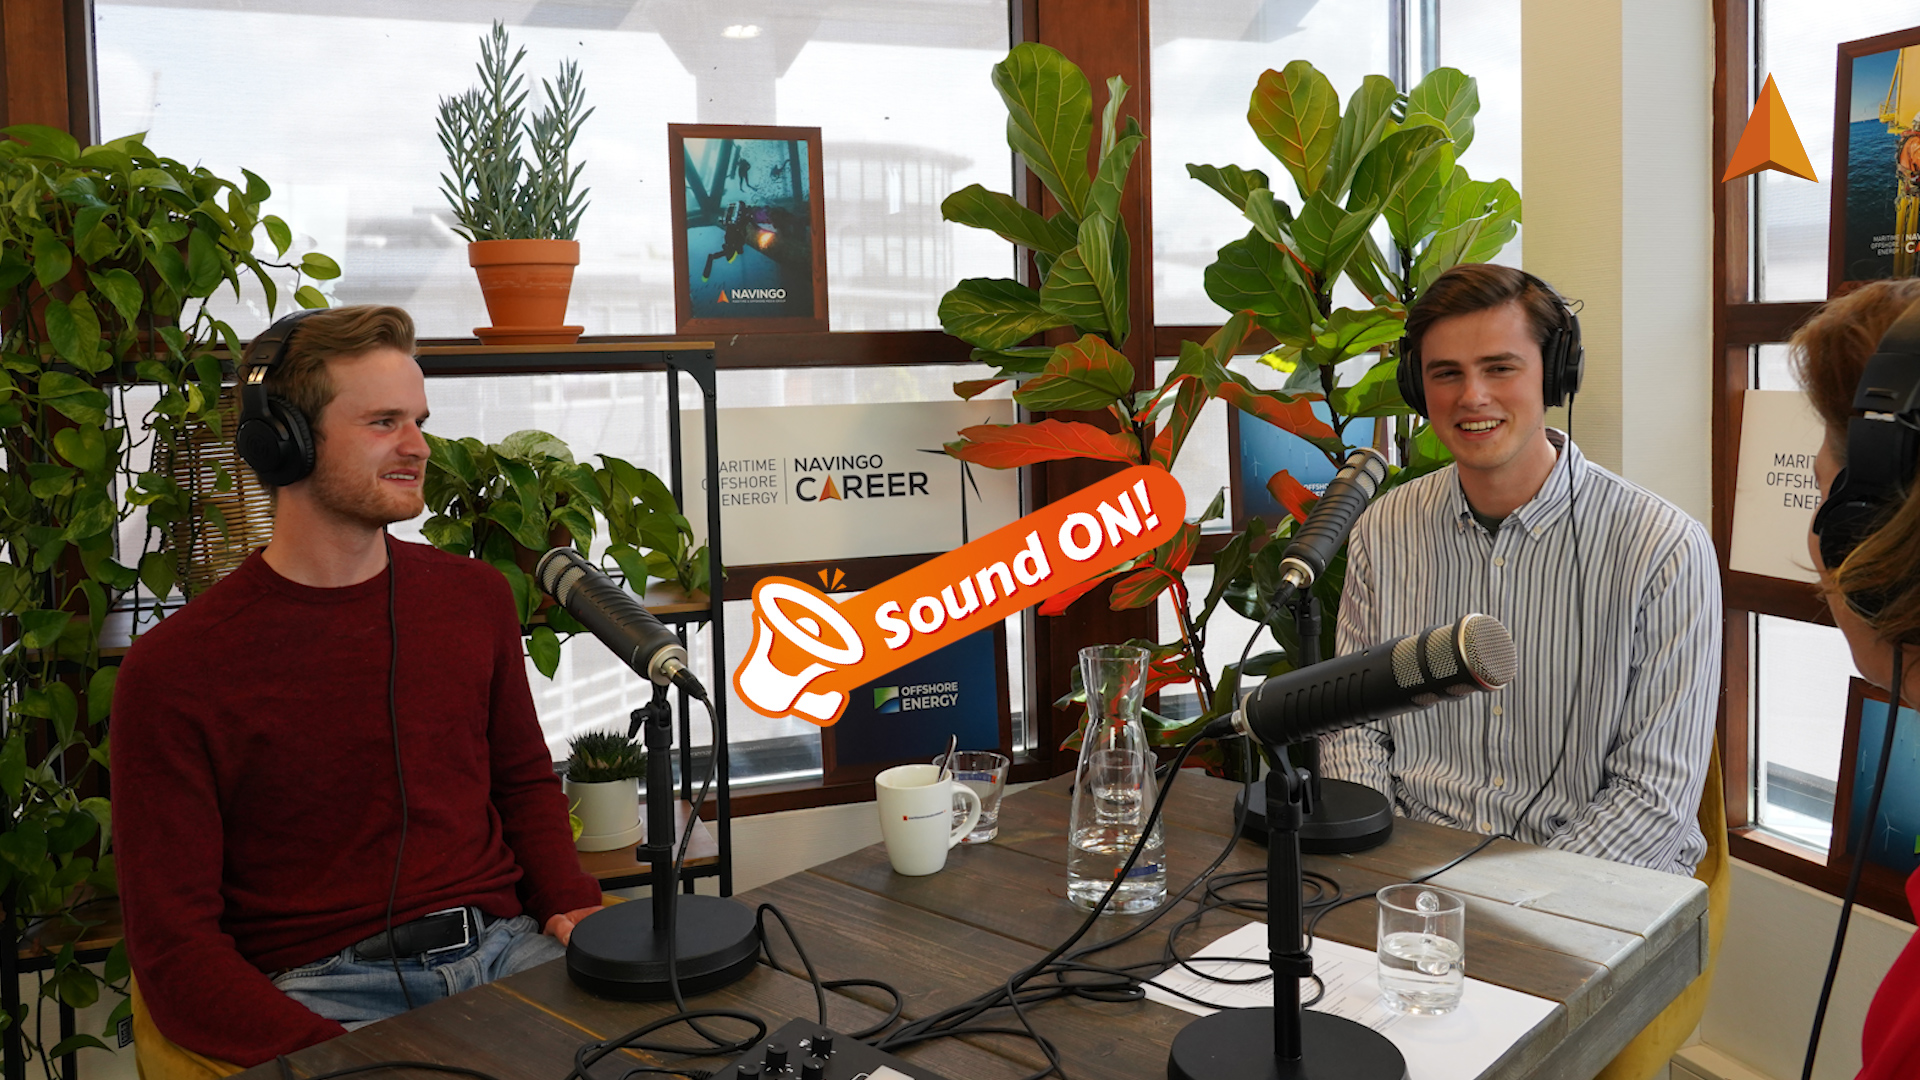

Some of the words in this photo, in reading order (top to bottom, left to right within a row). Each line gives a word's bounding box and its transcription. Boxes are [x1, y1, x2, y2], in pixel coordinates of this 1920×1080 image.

[731, 288, 787, 299] NAVINGO
[718, 458, 777, 474] ARITIME
[794, 454, 883, 473] NAVINGO
[1773, 452, 1817, 469] MARIT
[701, 475, 778, 491] OFSHORE
[796, 471, 930, 502] CAREER
[1766, 471, 1820, 490] OFFSH
[721, 491, 778, 507] ENERGY
[900, 681, 959, 697] OFFSHORE
[901, 693, 959, 712] ENERGY
